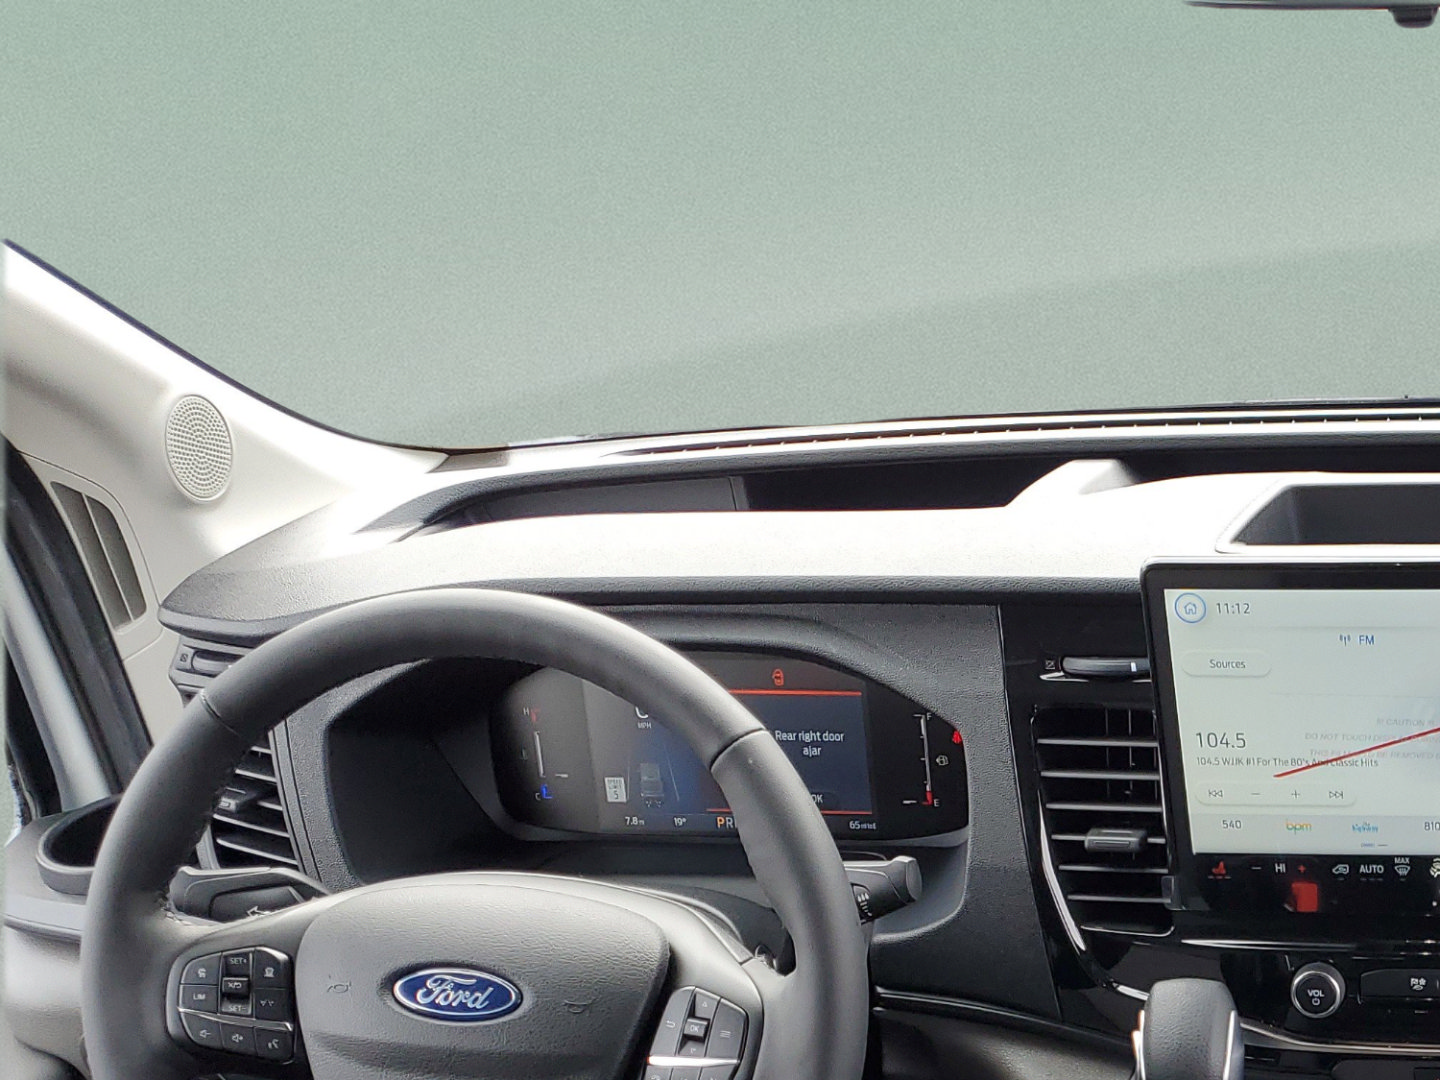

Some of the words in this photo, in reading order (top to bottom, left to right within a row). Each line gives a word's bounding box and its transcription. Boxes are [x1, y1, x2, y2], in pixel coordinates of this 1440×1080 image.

[1216, 602, 1251, 615] 11:12
[1358, 634, 1375, 646] FM
[1209, 658, 1246, 669] Sources
[523, 706, 530, 716] H
[926, 713, 932, 721] F
[637, 721, 652, 730] MPH
[775, 730, 797, 741] Rear
[798, 730, 821, 743] right
[822, 730, 845, 742] door
[1195, 732, 1247, 750] 104.5
[802, 745, 822, 758] ajar
[1196, 756, 1220, 767] 104.5
[1257, 756, 1270, 767] For
[1273, 757, 1290, 767] The
[1290, 757, 1310, 768] 80's
[1360, 758, 1379, 768] Hits
[934, 799, 939, 807] E
[1221, 819, 1242, 830] 540
[1285, 819, 1312, 835] bpm
[1394, 857, 1410, 865] MAX
[1275, 863, 1286, 874] HI
[1359, 864, 1385, 875] AUTO
[416, 974, 495, 1010] Ford
[1307, 989, 1325, 998] VOL
[689, 1024, 699, 1033] OK
